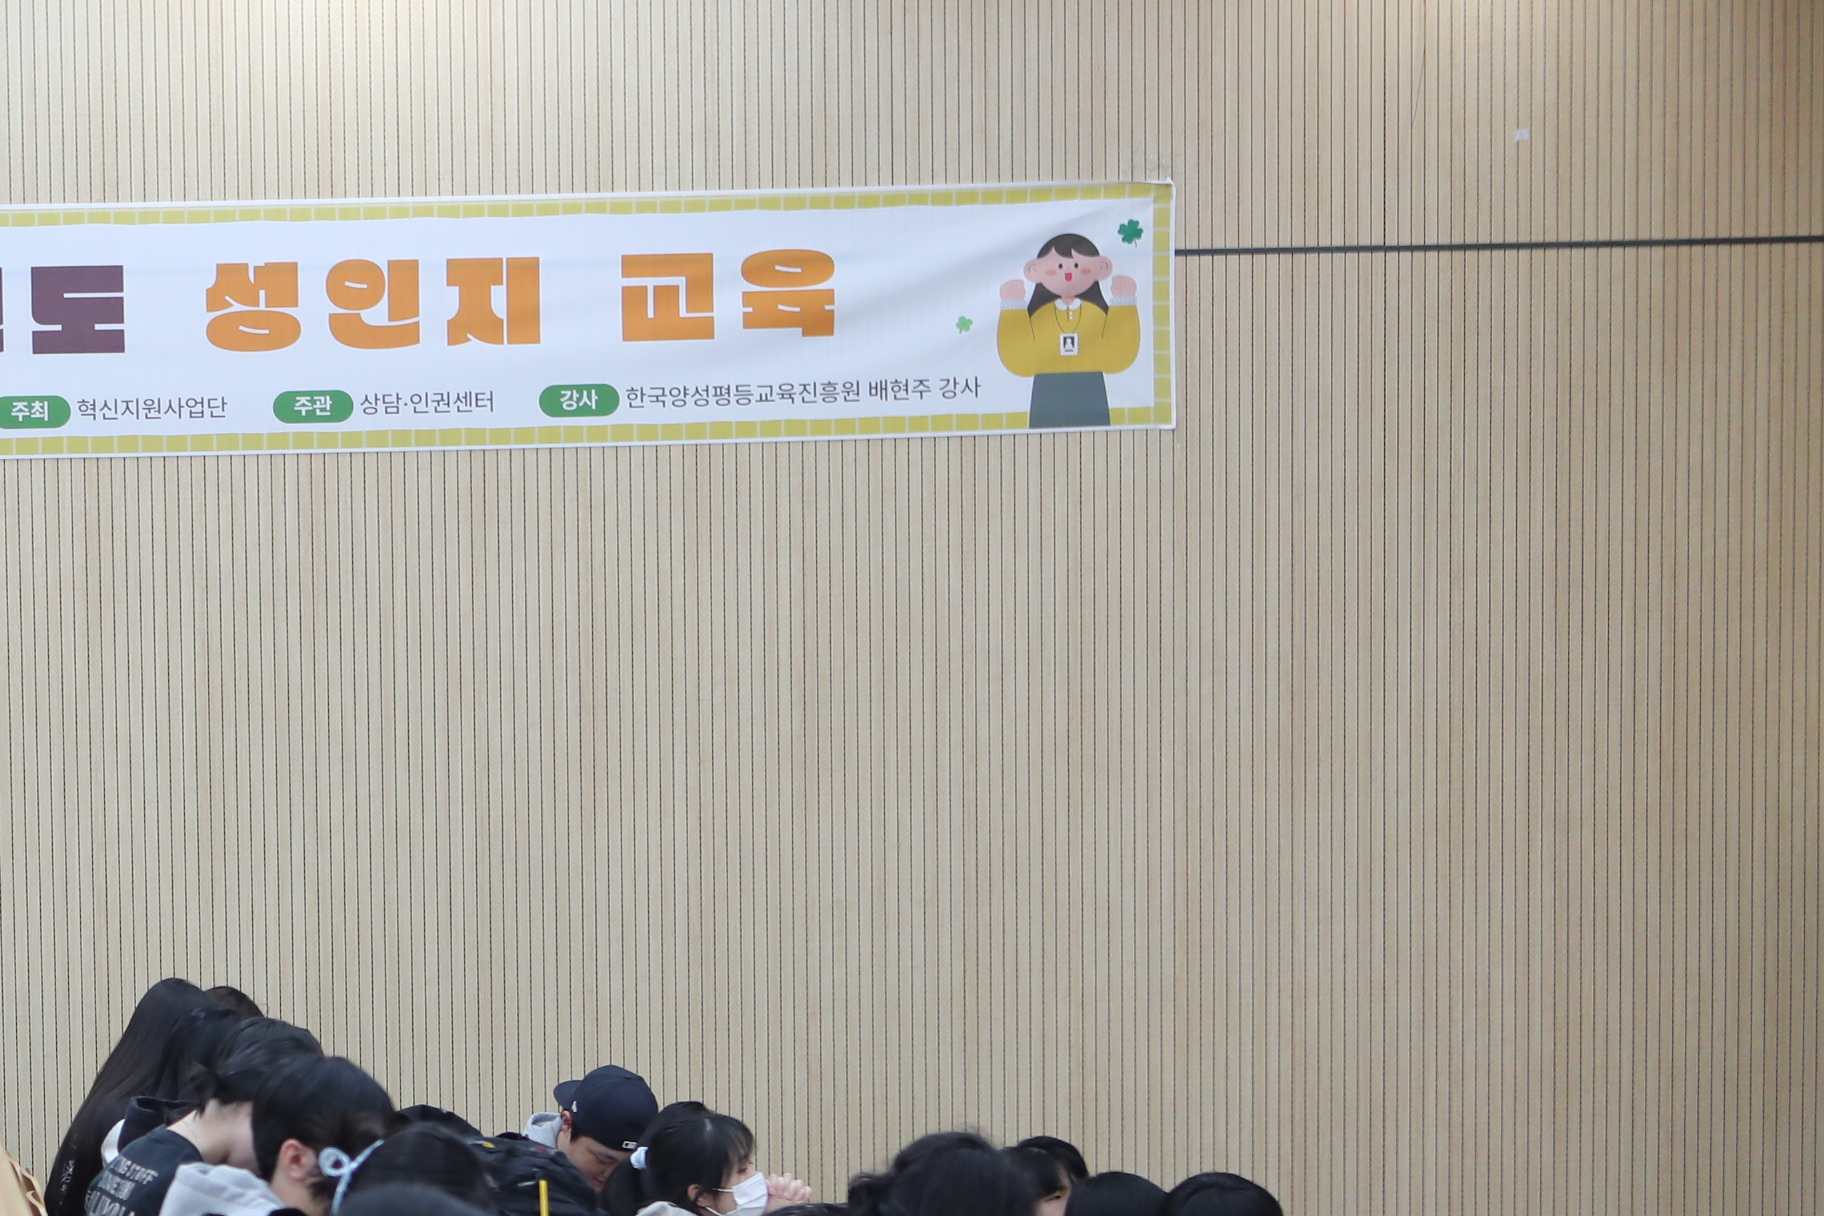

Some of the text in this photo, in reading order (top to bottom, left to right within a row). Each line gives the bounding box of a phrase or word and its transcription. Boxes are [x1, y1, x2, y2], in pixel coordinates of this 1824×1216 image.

[205, 256, 540, 352] 성인지
[621, 248, 835, 341] 교육
[294, 391, 493, 416] 주관 상담·인권센터
[560, 376, 980, 411] 강사 한국양성평등교육진흥원 배현주 강사
[11, 397, 227, 421] 주최 혁신지원사업단
